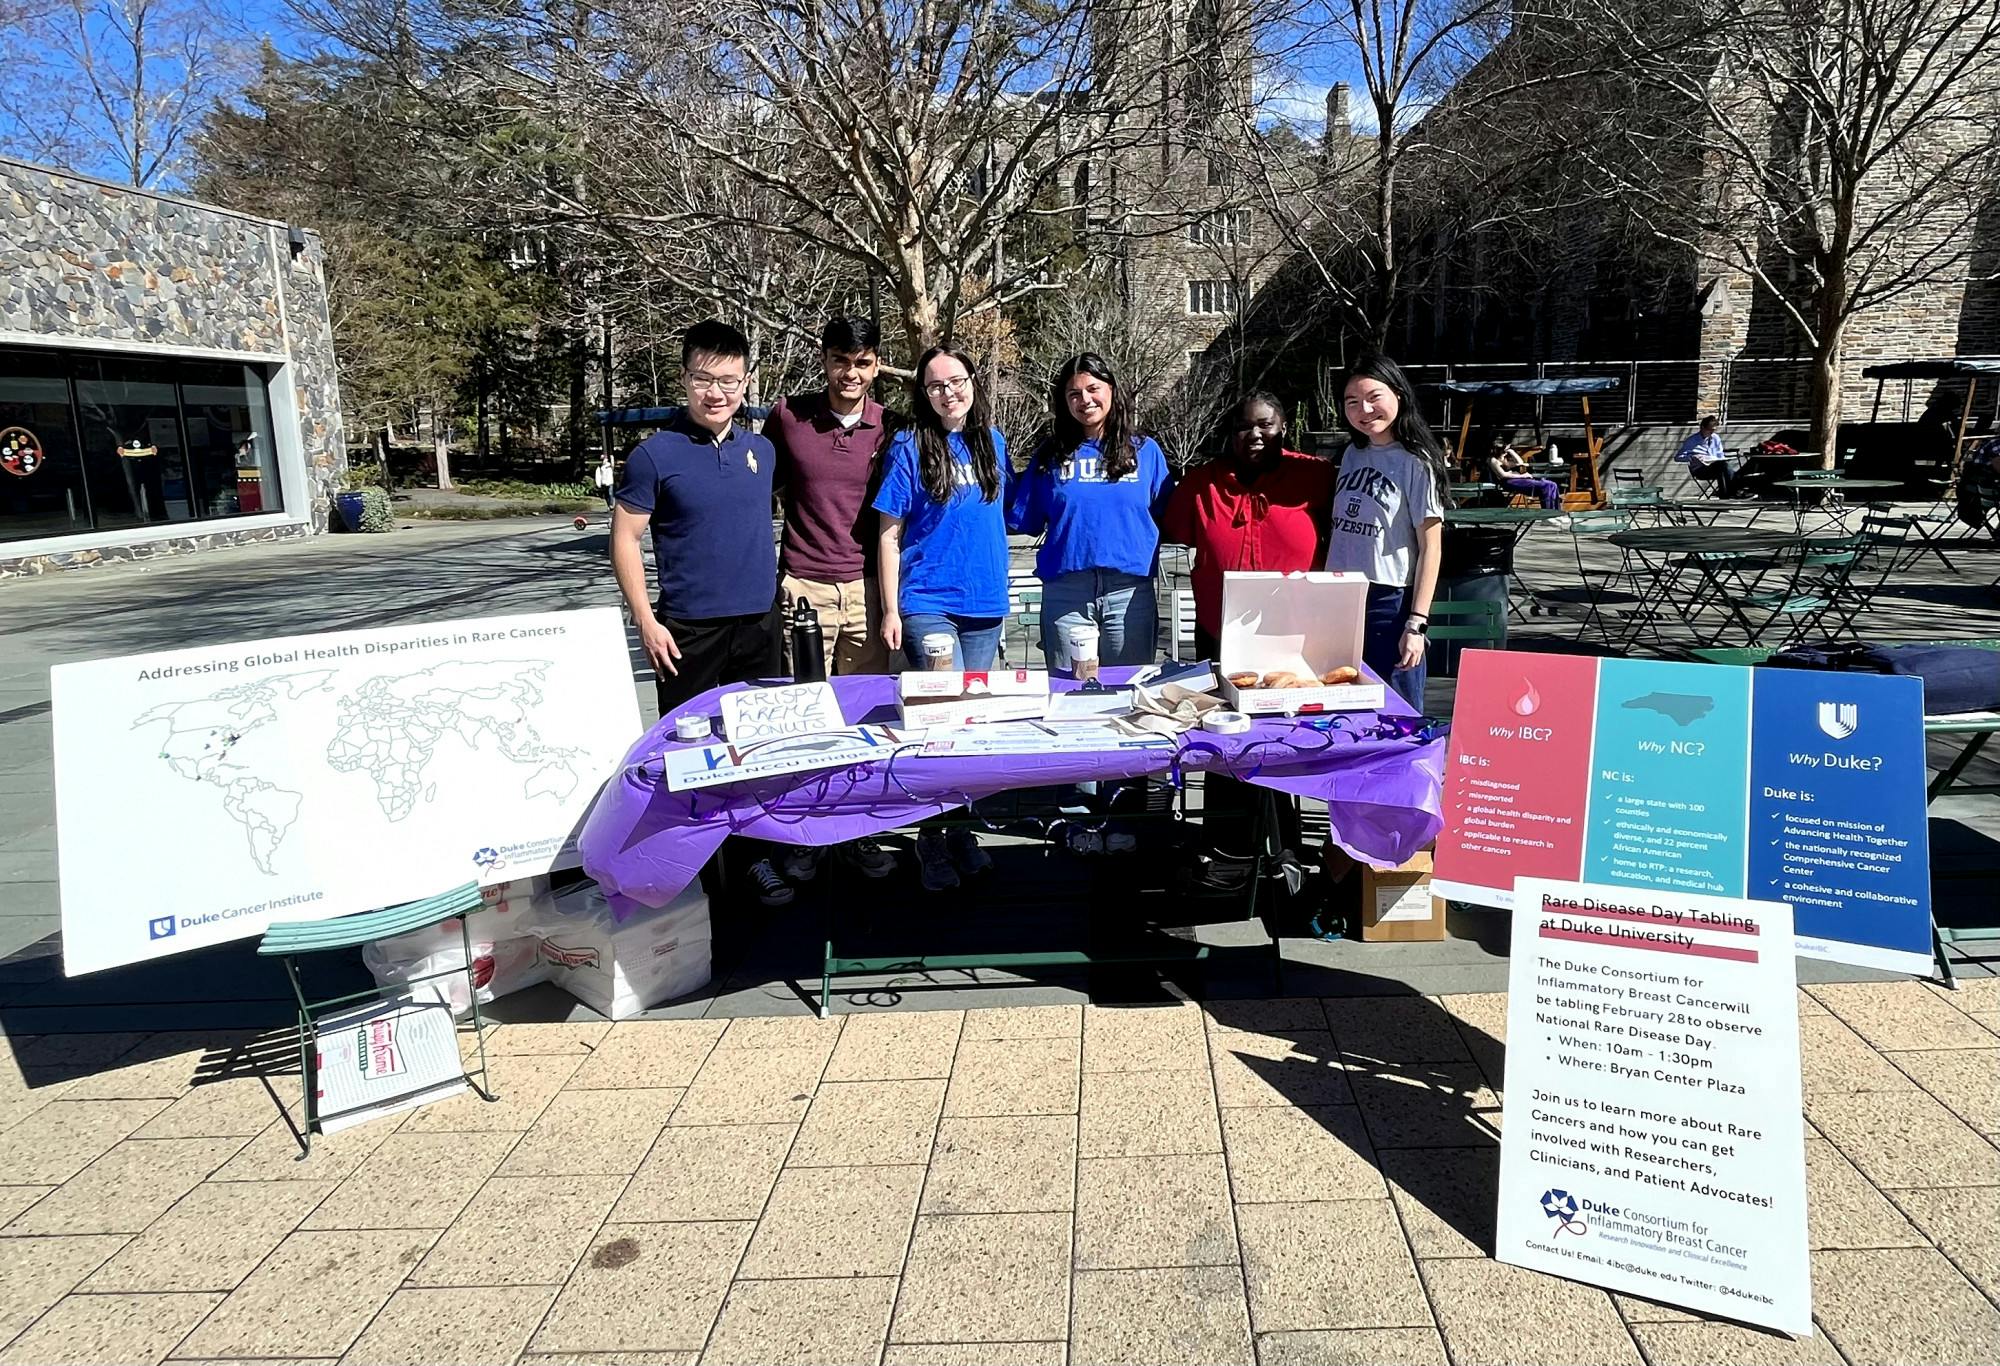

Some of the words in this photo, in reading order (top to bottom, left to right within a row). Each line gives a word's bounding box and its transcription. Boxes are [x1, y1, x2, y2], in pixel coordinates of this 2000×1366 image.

[138, 660, 239, 682] Addressing
[244, 651, 298, 667] Global
[305, 645, 359, 661] Health
[365, 637, 449, 654] Disparities
[453, 634, 467, 644] in
[472, 631, 505, 642] Rare
[510, 625, 566, 639] Cancers
[736, 686, 823, 707] KRISPY
[739, 703, 824, 722] KREME
[736, 718, 826, 739] DONUTS
[1489, 726, 1514, 740] Why
[1519, 726, 1553, 741] IBC?
[1638, 741, 1665, 754] Why
[1671, 741, 1705, 756] NC?
[683, 761, 800, 783] Duke-NCCU
[808, 752, 869, 763] Bridge
[1459, 754, 1476, 765] IBC
[1479, 757, 1490, 767] is:
[1789, 753, 1820, 768] Why
[1824, 753, 1883, 771] Duke?
[1470, 778, 1520, 791] misdiagnosed
[1602, 770, 1619, 781] NC
[1622, 772, 1634, 782] is:
[1469, 792, 1513, 804] misreported
[1625, 796, 1644, 806] large
[1646, 799, 1667, 808] state
[1668, 801, 1686, 810] with
[1689, 804, 1705, 812] 100
[1764, 787, 1797, 800] Duke
[1800, 791, 1815, 802] is:
[1473, 805, 1495, 815] global
[1497, 808, 1520, 818] health
[1522, 811, 1555, 823] disparity
[1556, 816, 1571, 825] and
[1616, 807, 1650, 817] counties
[1464, 817, 1486, 826] global
[1488, 819, 1515, 829] burden
[1616, 821, 1654, 833] ethnically
[1656, 826, 1671, 834] and
[1673, 829, 1727, 842] economically
[1785, 814, 1820, 825] focused
[1837, 820, 1872, 831] mission
[1874, 824, 1885, 832] of
[1464, 830, 1501, 842] applicable
[1503, 835, 1511, 843] to
[1513, 837, 1544, 848] research
[1646, 836, 1662, 845] and
[1664, 838, 1674, 846] 22
[1676, 840, 1708, 850] percent
[1783, 826, 1830, 840] Advancing
[1832, 831, 1863, 842] Health
[1865, 835, 1908, 847] Together
[500, 843, 525, 854] Duke
[1461, 842, 1482, 851] other
[1483, 845, 1512, 855] cancers
[1613, 844, 1641, 854] African
[1643, 847, 1682, 859] American
[1785, 841, 1800, 850] the
[1803, 844, 1848, 857] nationally
[1850, 850, 1902, 862] recognized
[1613, 858, 1636, 867] home
[1639, 861, 1647, 869] to
[1649, 862, 1667, 871] RTP:
[1783, 853, 1854, 869] Comprehensive
[1857, 862, 1891, 873] Cancer
[1783, 865, 1814, 876] Center
[1655, 876, 1671, 884] and
[1673, 878, 1705, 889] medical
[1707, 882, 1724, 892] hub
[1792, 883, 1832, 895] cohesive
[1835, 888, 1853, 897] and
[1855, 891, 1918, 906] collaborative
[181, 913, 220, 928] Duke
[222, 902, 267, 919] Cancer
[269, 891, 323, 909] Institute
[1783, 894, 1843, 908] environment
[1542, 894, 1578, 908] Rare
[1583, 898, 1646, 916] Disease
[1651, 905, 1683, 923] Day
[1688, 909, 1754, 932] Tabling
[1540, 918, 1556, 929] at
[1561, 919, 1603, 935] Duke
[1609, 925, 1694, 949] University
[1538, 957, 1560, 969] The
[1564, 960, 1597, 974] Duke
[1601, 966, 1679, 985] Consortium
[1684, 975, 1703, 988] for
[1537, 976, 1624, 998] Inflammatory
[1629, 988, 1671, 1003] Breast
[1537, 994, 1551, 1005] be
[1555, 997, 1600, 1014] tabling
[1603, 1003, 1663, 1023] February
[1668, 1012, 1685, 1024] 28
[1688, 1016, 1701, 1027] to
[1706, 1018, 1762, 1036] observe
[1536, 1013, 1589, 1030] National
[1595, 1021, 1624, 1034] Rare
[1629, 1026, 1680, 1044] Disease
[1559, 1035, 1602, 1051] When:
[1606, 1043, 1643, 1058] 10am
[1659, 1051, 1713, 1069] 1:30pm
[1558, 1054, 1607, 1072] Where:
[1610, 1063, 1649, 1079] Bryan
[1654, 1070, 1702, 1087] Center
[1707, 1078, 1745, 1095] Plaza
[1532, 1089, 1560, 1104] Join
[1564, 1097, 1579, 1107] us
[1583, 1099, 1597, 1110] to
[1601, 1101, 1636, 1117] learn
[1640, 1110, 1677, 1124] more
[1681, 1117, 1723, 1133] about
[1728, 1123, 1762, 1140] Rare
[1531, 1109, 1585, 1129] Cancers
[1589, 1121, 1614, 1134] and
[1619, 1125, 1647, 1140] how
[1652, 1133, 1677, 1146] you
[1682, 1140, 1707, 1152] can
[1712, 1144, 1735, 1157] get
[1531, 1129, 1586, 1149] involved
[1590, 1141, 1619, 1156] with
[1624, 1147, 1717, 1177] Researchers,
[1530, 1149, 1599, 1175] Clinicians,
[1604, 1165, 1630, 1179] and
[1635, 1170, 1686, 1191] Patient
[1690, 1181, 1774, 1209] Advocates!
[1582, 1199, 1620, 1217] Duke
[1623, 1208, 1689, 1232] Consortium
[1692, 1221, 1709, 1236] for
[1587, 1213, 1662, 1243] Inflammatory
[1666, 1231, 1703, 1250] Breast
[1706, 1239, 1748, 1259] Cancer
[1598, 1231, 1628, 1244] Research
[1630, 1238, 1666, 1253] Innovation
[1668, 1246, 1681, 1255] and
[1683, 1249, 1709, 1262] Clinical
[1710, 1255, 1748, 1271] Excellence
[1525, 1240, 1558, 1254] Contact
[1561, 1247, 1575, 1258] Us!
[1577, 1252, 1604, 1266] Email:
[1680, 1275, 1716, 1291] Twitter:
[1719, 1285, 1774, 1305] @4dukeibc
